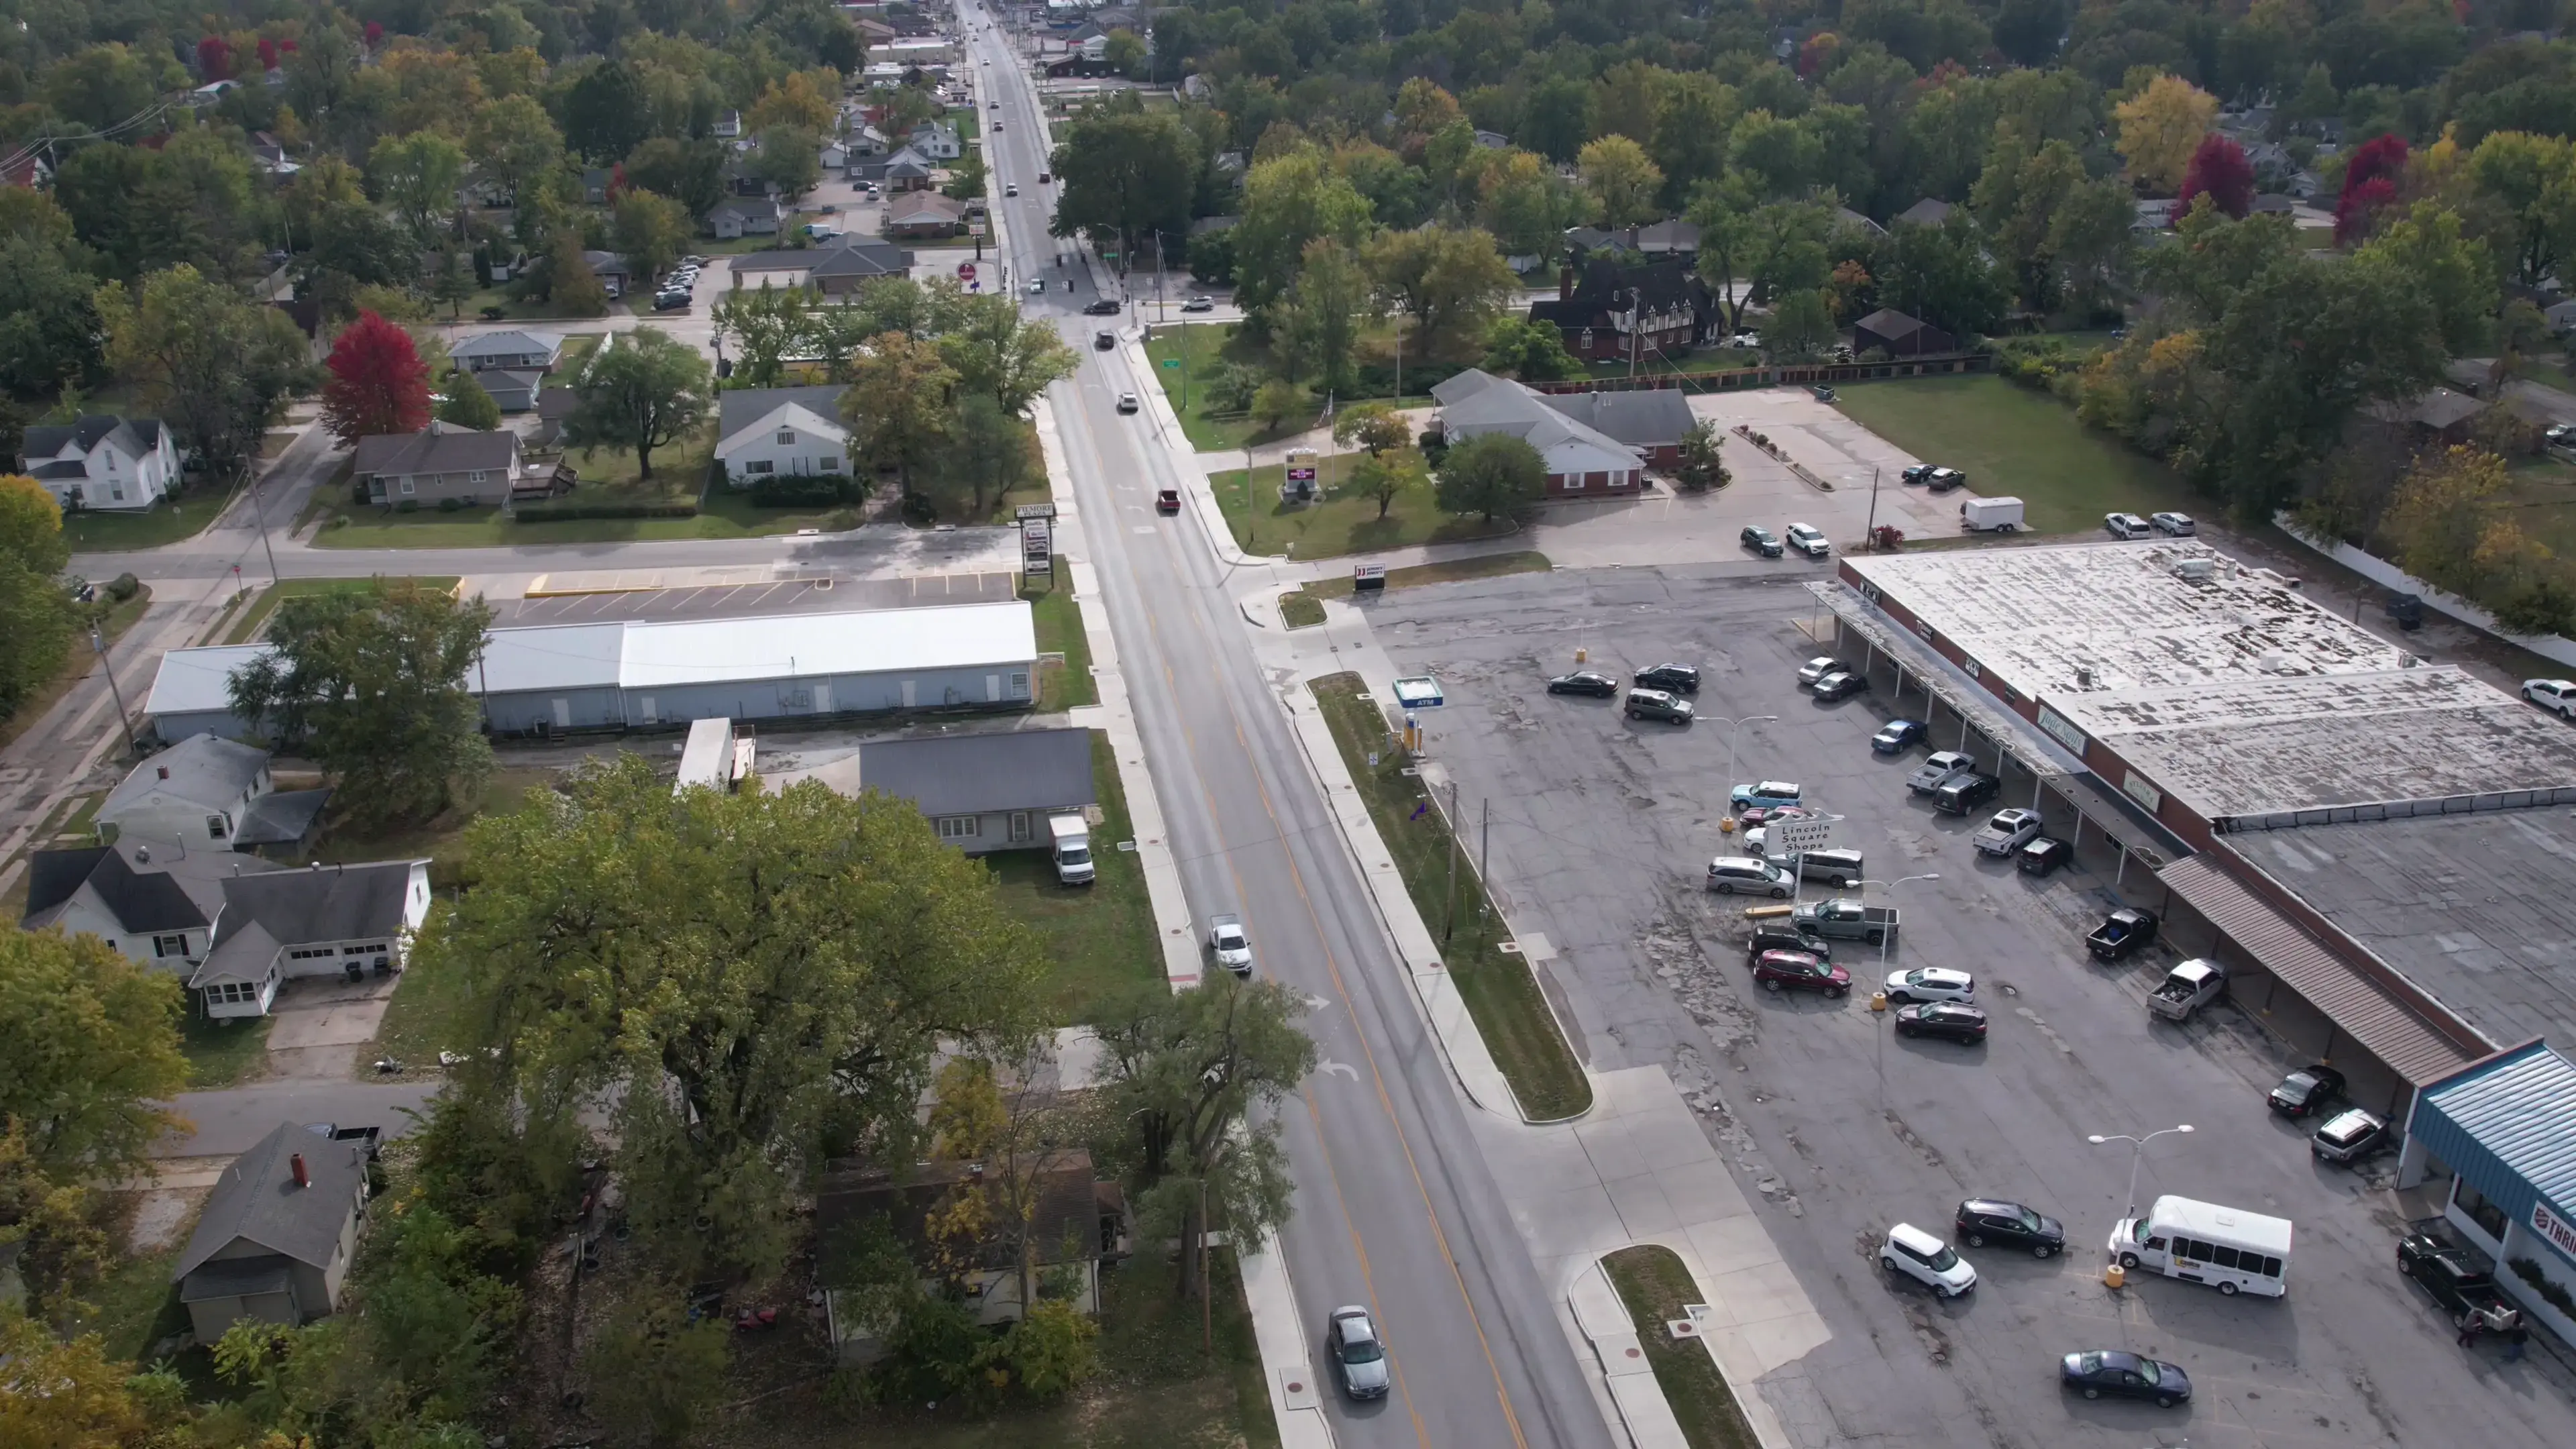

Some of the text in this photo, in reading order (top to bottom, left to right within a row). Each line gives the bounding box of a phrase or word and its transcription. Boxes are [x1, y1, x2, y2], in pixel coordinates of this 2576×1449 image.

[1782, 824, 1829, 834] Lincoln
[1782, 833, 1828, 843] Square
[1785, 843, 1823, 851] Shops
